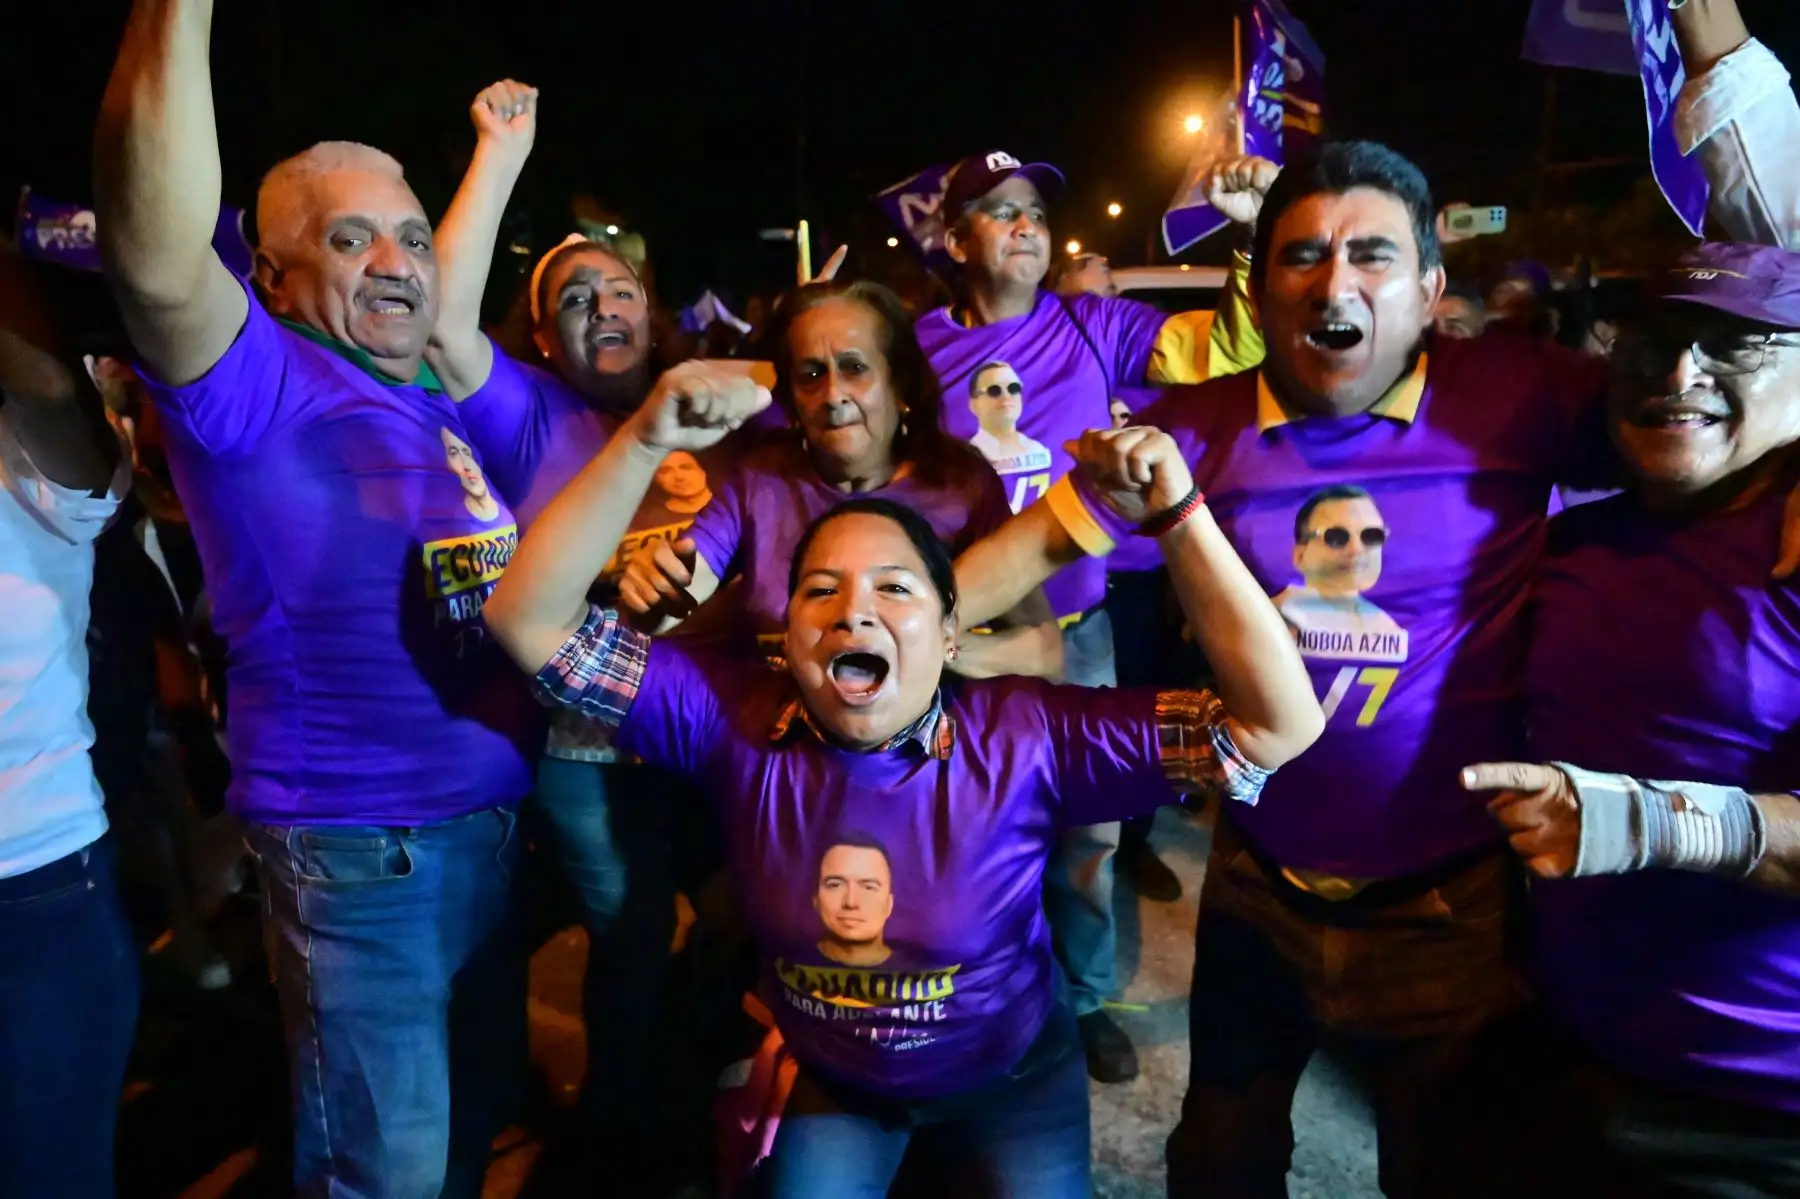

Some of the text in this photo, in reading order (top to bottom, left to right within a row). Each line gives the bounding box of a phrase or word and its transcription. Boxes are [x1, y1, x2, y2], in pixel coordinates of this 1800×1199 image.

[430, 532, 517, 588] ECUADO
[1297, 629, 1400, 655] NOBOA AZIN
[784, 987, 827, 1020] PARA
